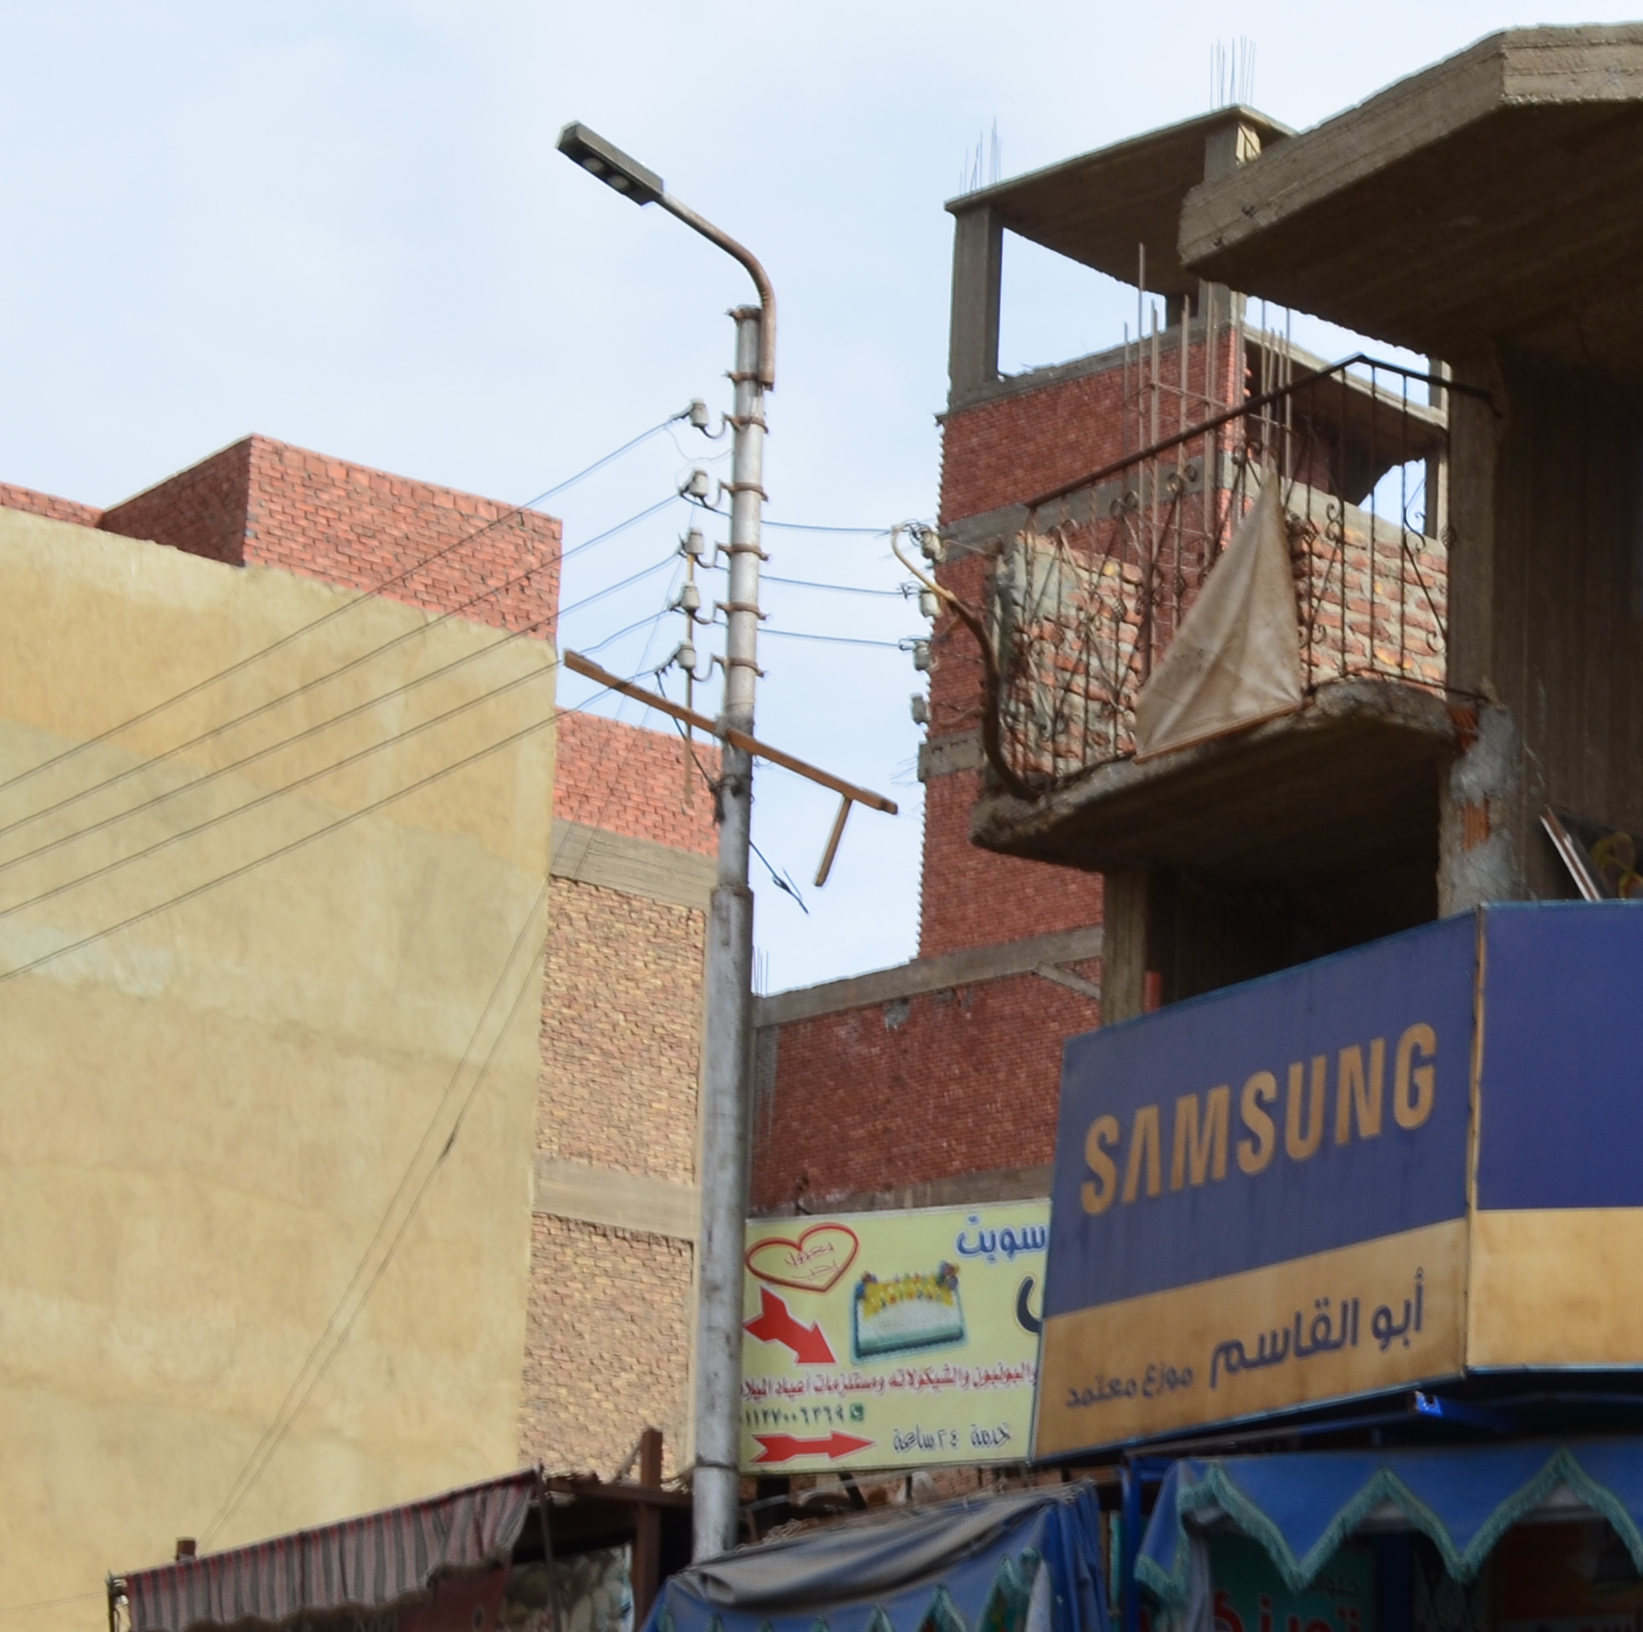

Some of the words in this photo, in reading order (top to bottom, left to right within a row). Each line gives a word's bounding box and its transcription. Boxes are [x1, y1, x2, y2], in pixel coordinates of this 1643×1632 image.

[1081, 1022, 1437, 1215] SAMSUNG
[1208, 1290, 1360, 1388] القاسم
[1369, 1269, 1425, 1351] أبو
[1065, 1373, 1135, 1410] معتمد
[1139, 1362, 1194, 1407] موزع
